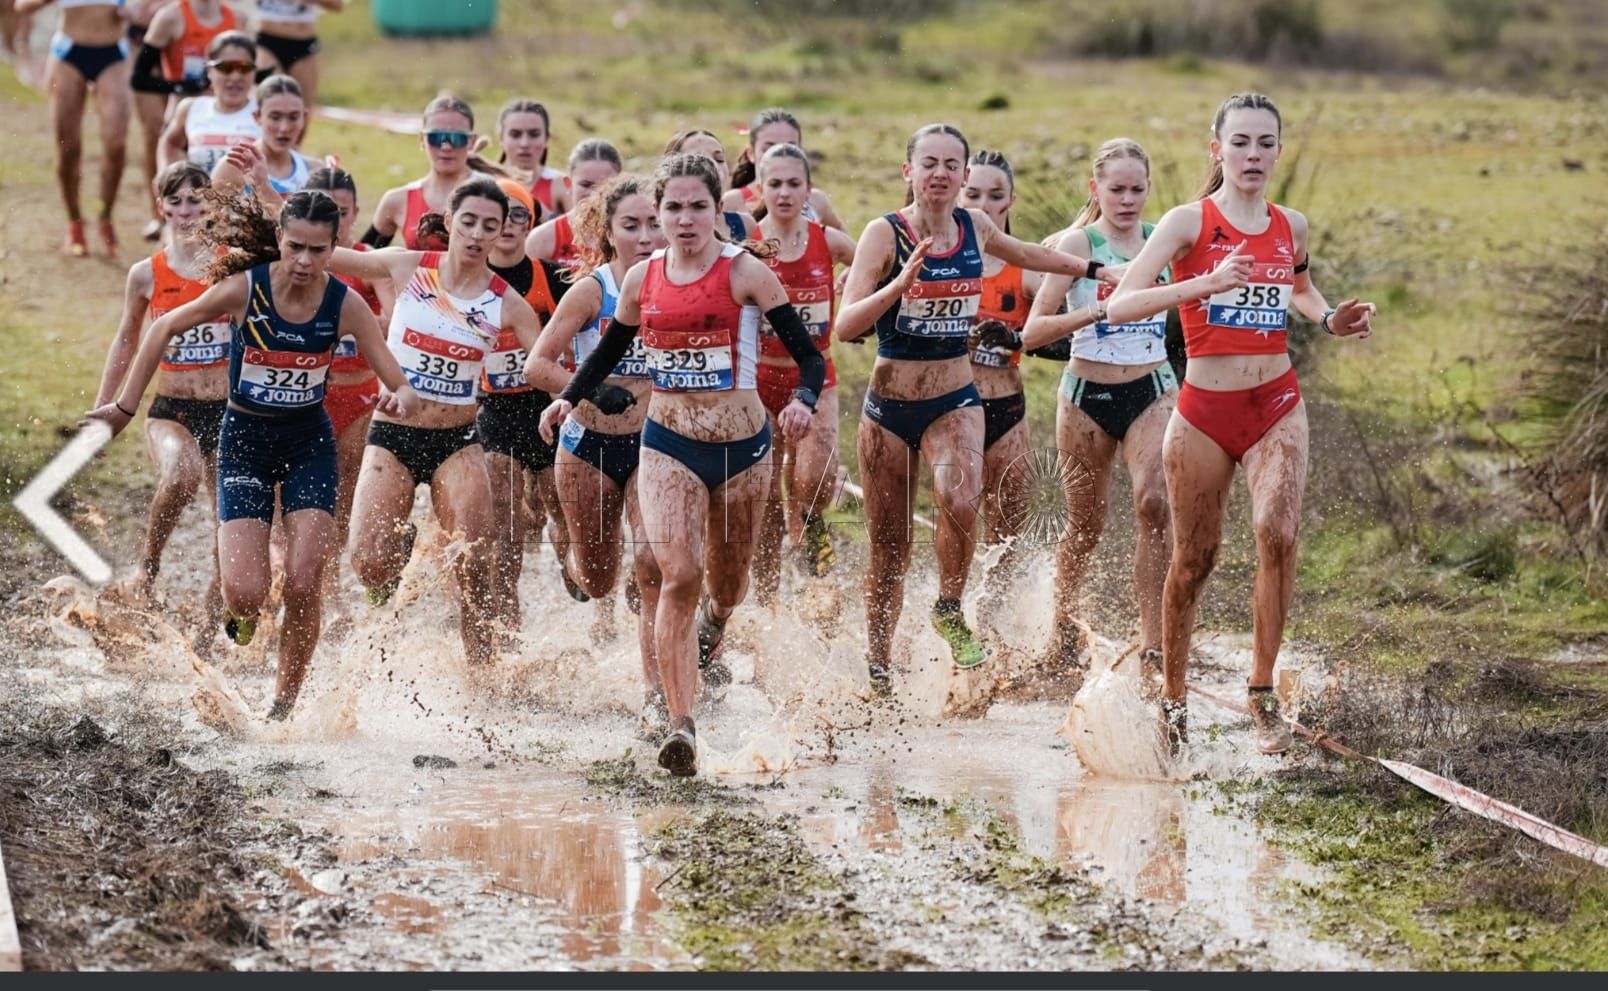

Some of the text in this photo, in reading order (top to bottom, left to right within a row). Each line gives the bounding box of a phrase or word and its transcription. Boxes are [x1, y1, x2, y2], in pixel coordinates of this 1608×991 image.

[1235, 286, 1280, 308] 358
[922, 298, 962, 318] 320
[415, 353, 459, 380] 339
[662, 350, 707, 371] 329
[263, 368, 310, 389] 324
